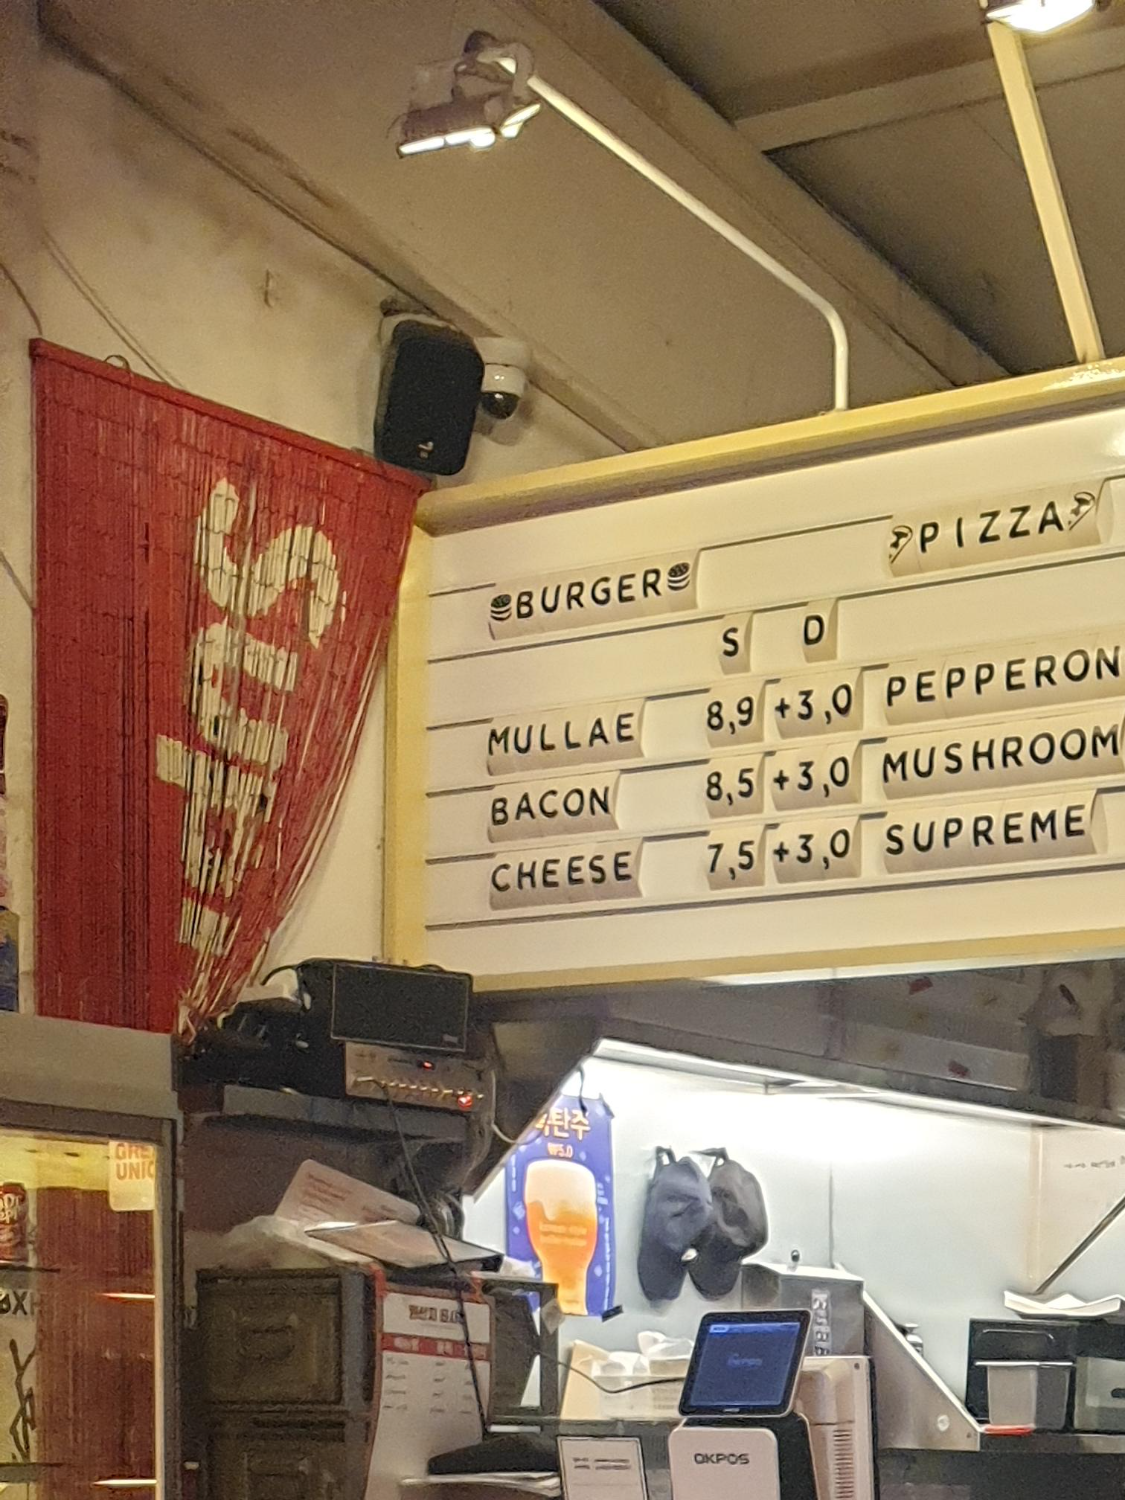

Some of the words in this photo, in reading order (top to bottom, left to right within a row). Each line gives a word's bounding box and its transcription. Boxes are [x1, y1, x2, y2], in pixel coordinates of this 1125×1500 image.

[919, 501, 1063, 553] PIZZA
[515, 568, 662, 620] BURGER
[721, 628, 740, 657] S
[803, 615, 825, 645] D
[487, 712, 635, 757] MULLAE
[883, 724, 1120, 783] MUSHROOM
[491, 786, 610, 826] BACON
[885, 803, 1086, 856] SUPREME
[491, 849, 634, 893] CHEESE
[693, 1453, 750, 1466] OKPOS
